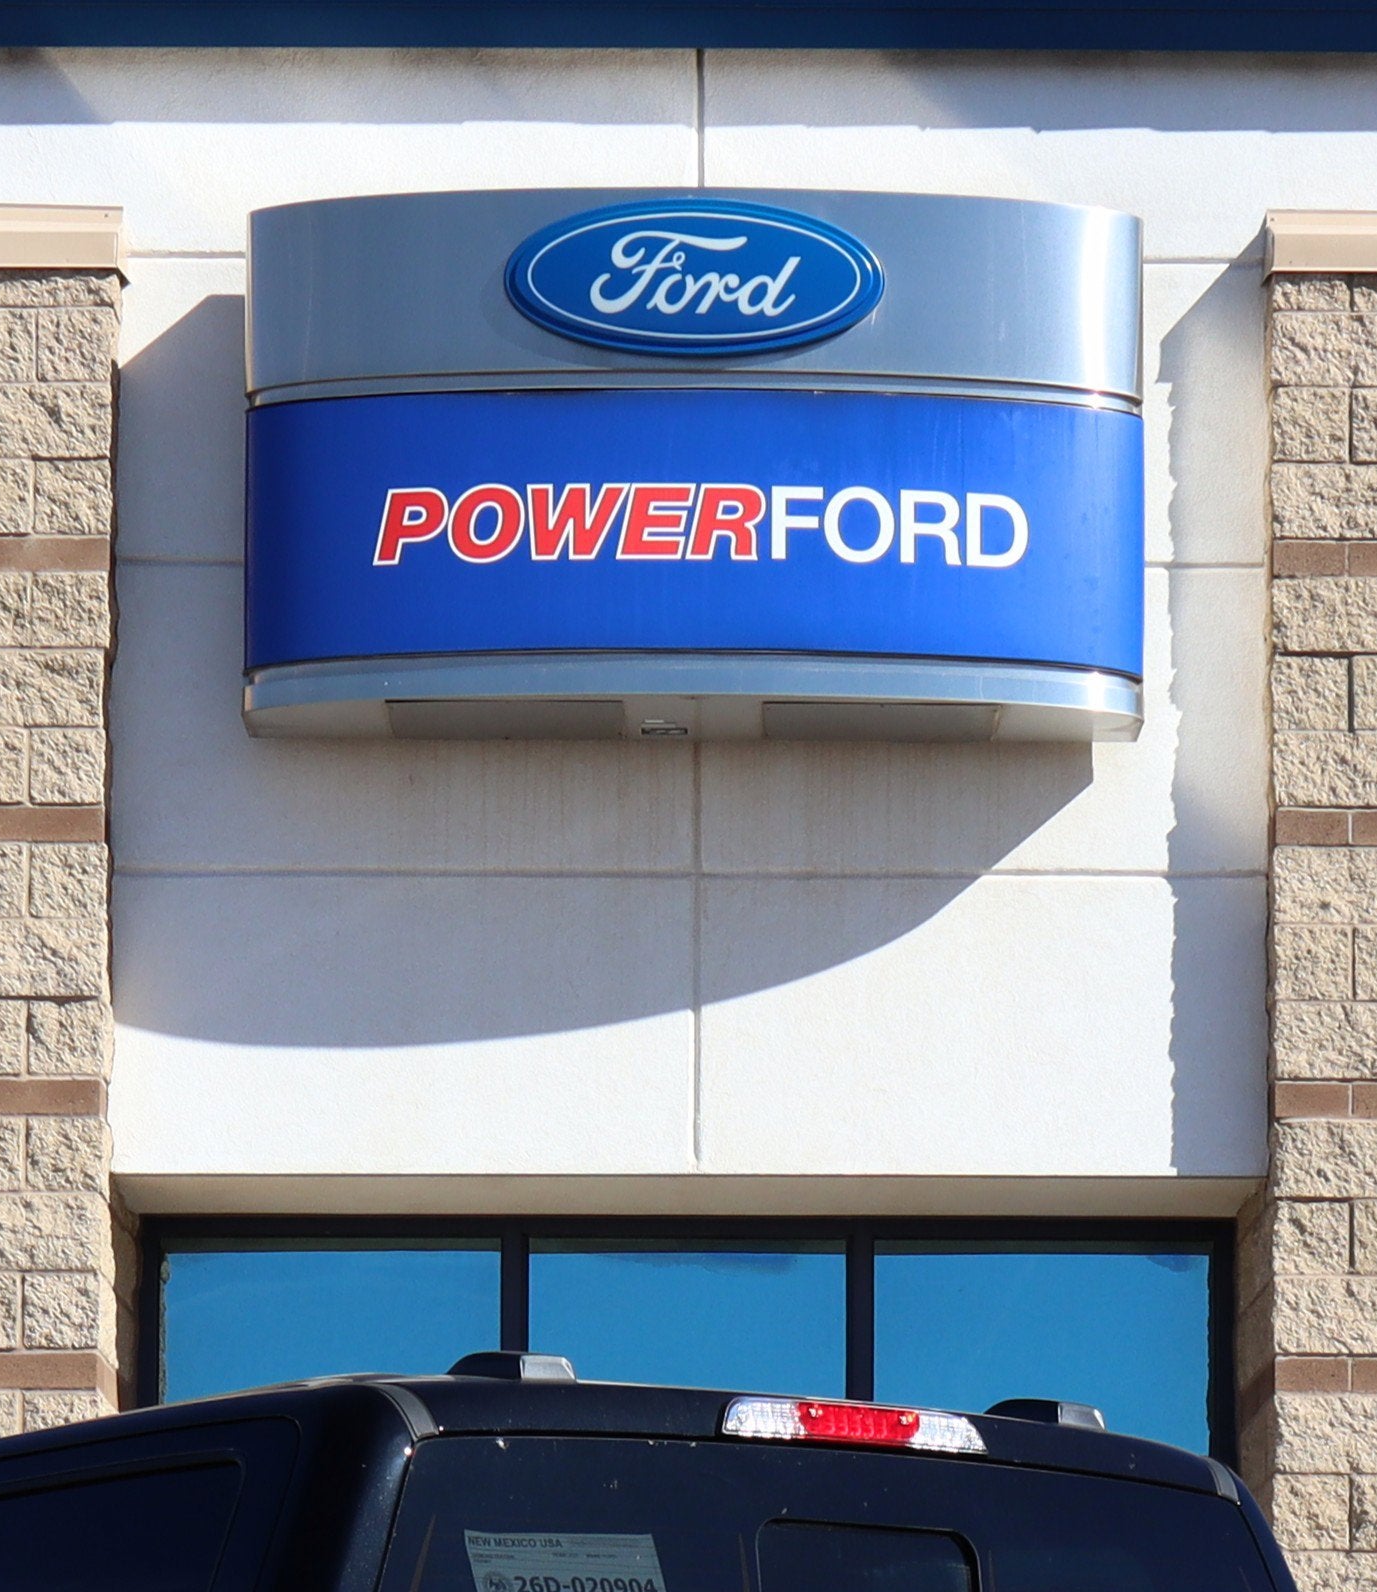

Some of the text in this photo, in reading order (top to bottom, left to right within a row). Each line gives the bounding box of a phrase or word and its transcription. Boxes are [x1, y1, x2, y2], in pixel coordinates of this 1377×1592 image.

[590, 230, 802, 317] Ford
[372, 483, 1028, 569] POWERFORD
[468, 1536, 491, 1547] NEW
[494, 1537, 536, 1547] MEXICO
[539, 1538, 563, 1548] USA
